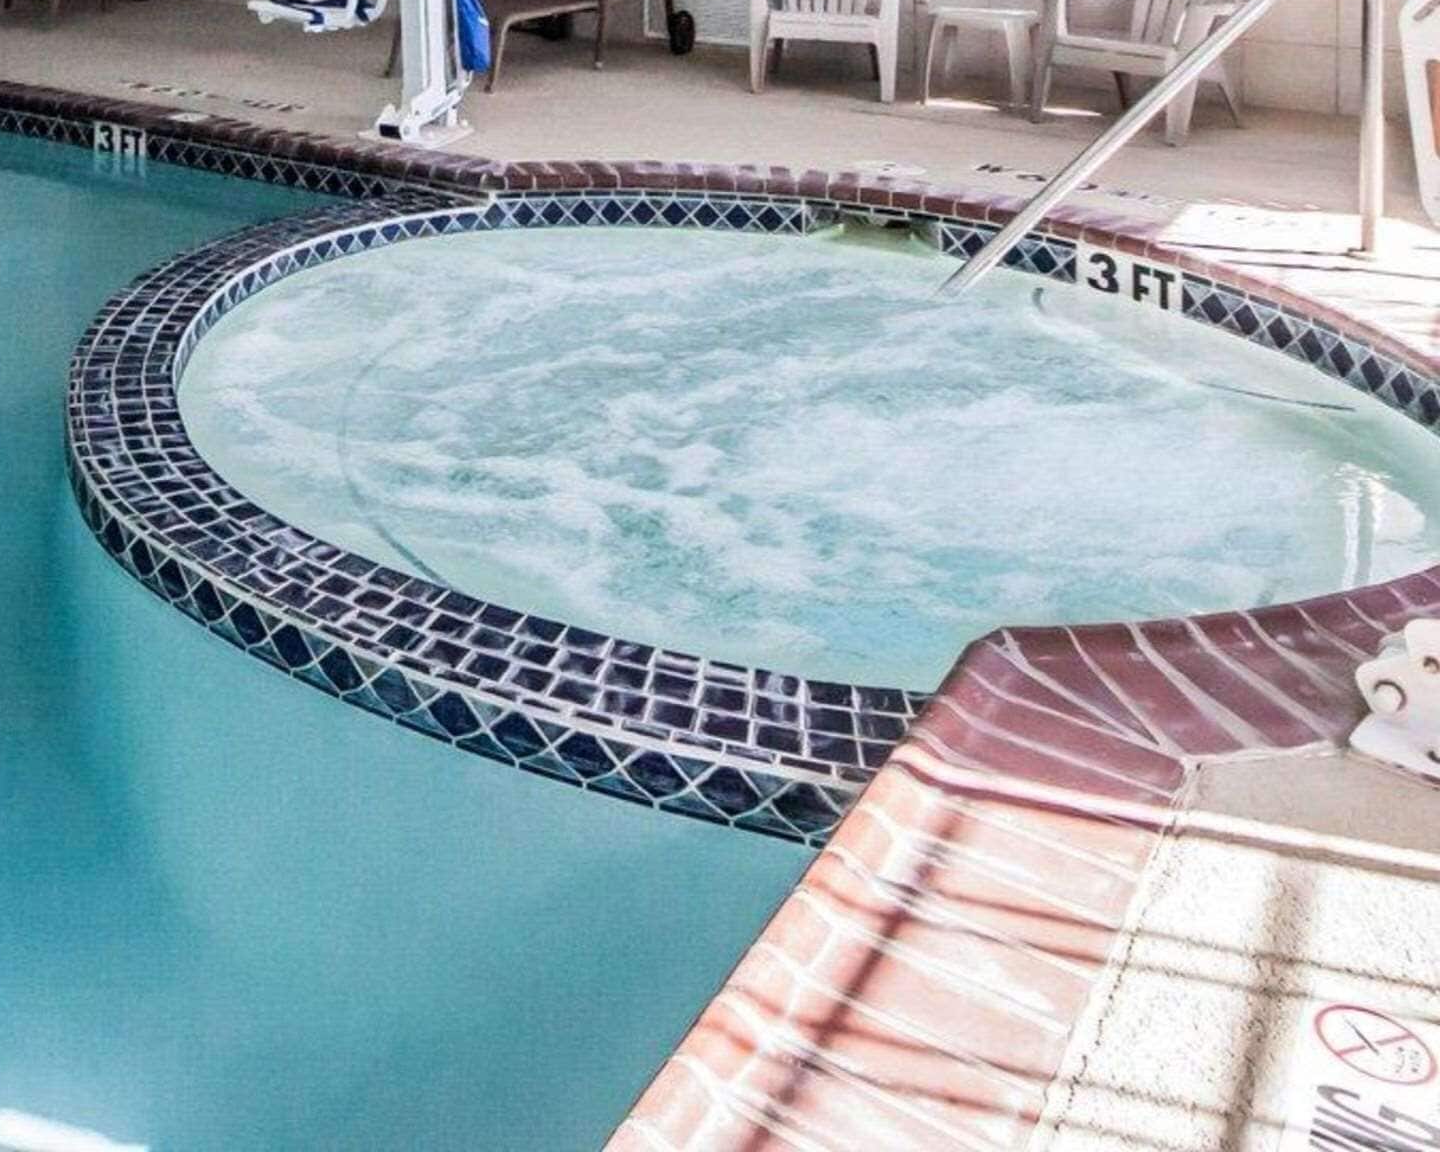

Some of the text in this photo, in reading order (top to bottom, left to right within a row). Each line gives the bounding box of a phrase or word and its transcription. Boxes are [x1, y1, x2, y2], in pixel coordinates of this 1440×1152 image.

[120, 129, 144, 156] FT
[1087, 253, 1176, 310] 3 FT
